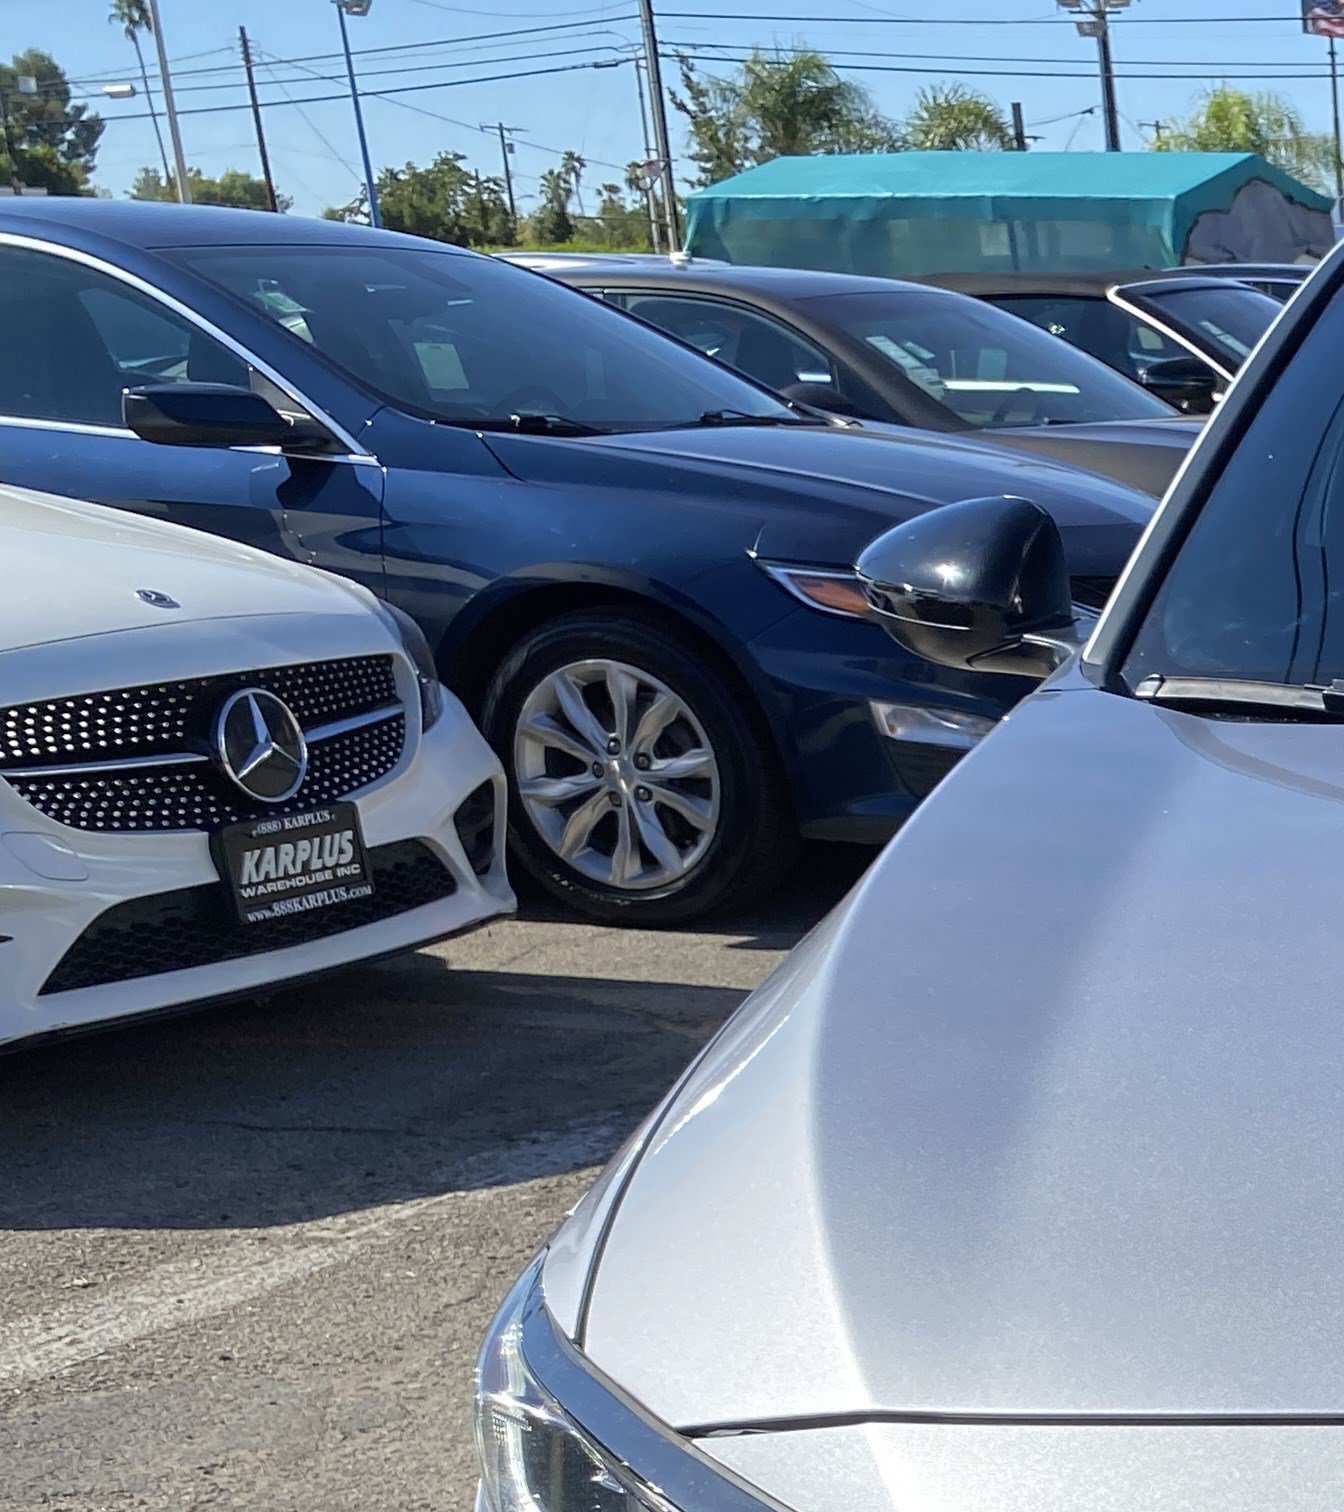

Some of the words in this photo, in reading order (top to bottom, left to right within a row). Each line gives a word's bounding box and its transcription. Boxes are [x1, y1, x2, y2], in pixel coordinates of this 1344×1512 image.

[257, 819, 282, 835] (888)
[284, 809, 331, 831] KARPLUS
[241, 830, 354, 885] KARPLUS
[240, 869, 334, 899] WAREHOUSE
[336, 863, 361, 878] INC
